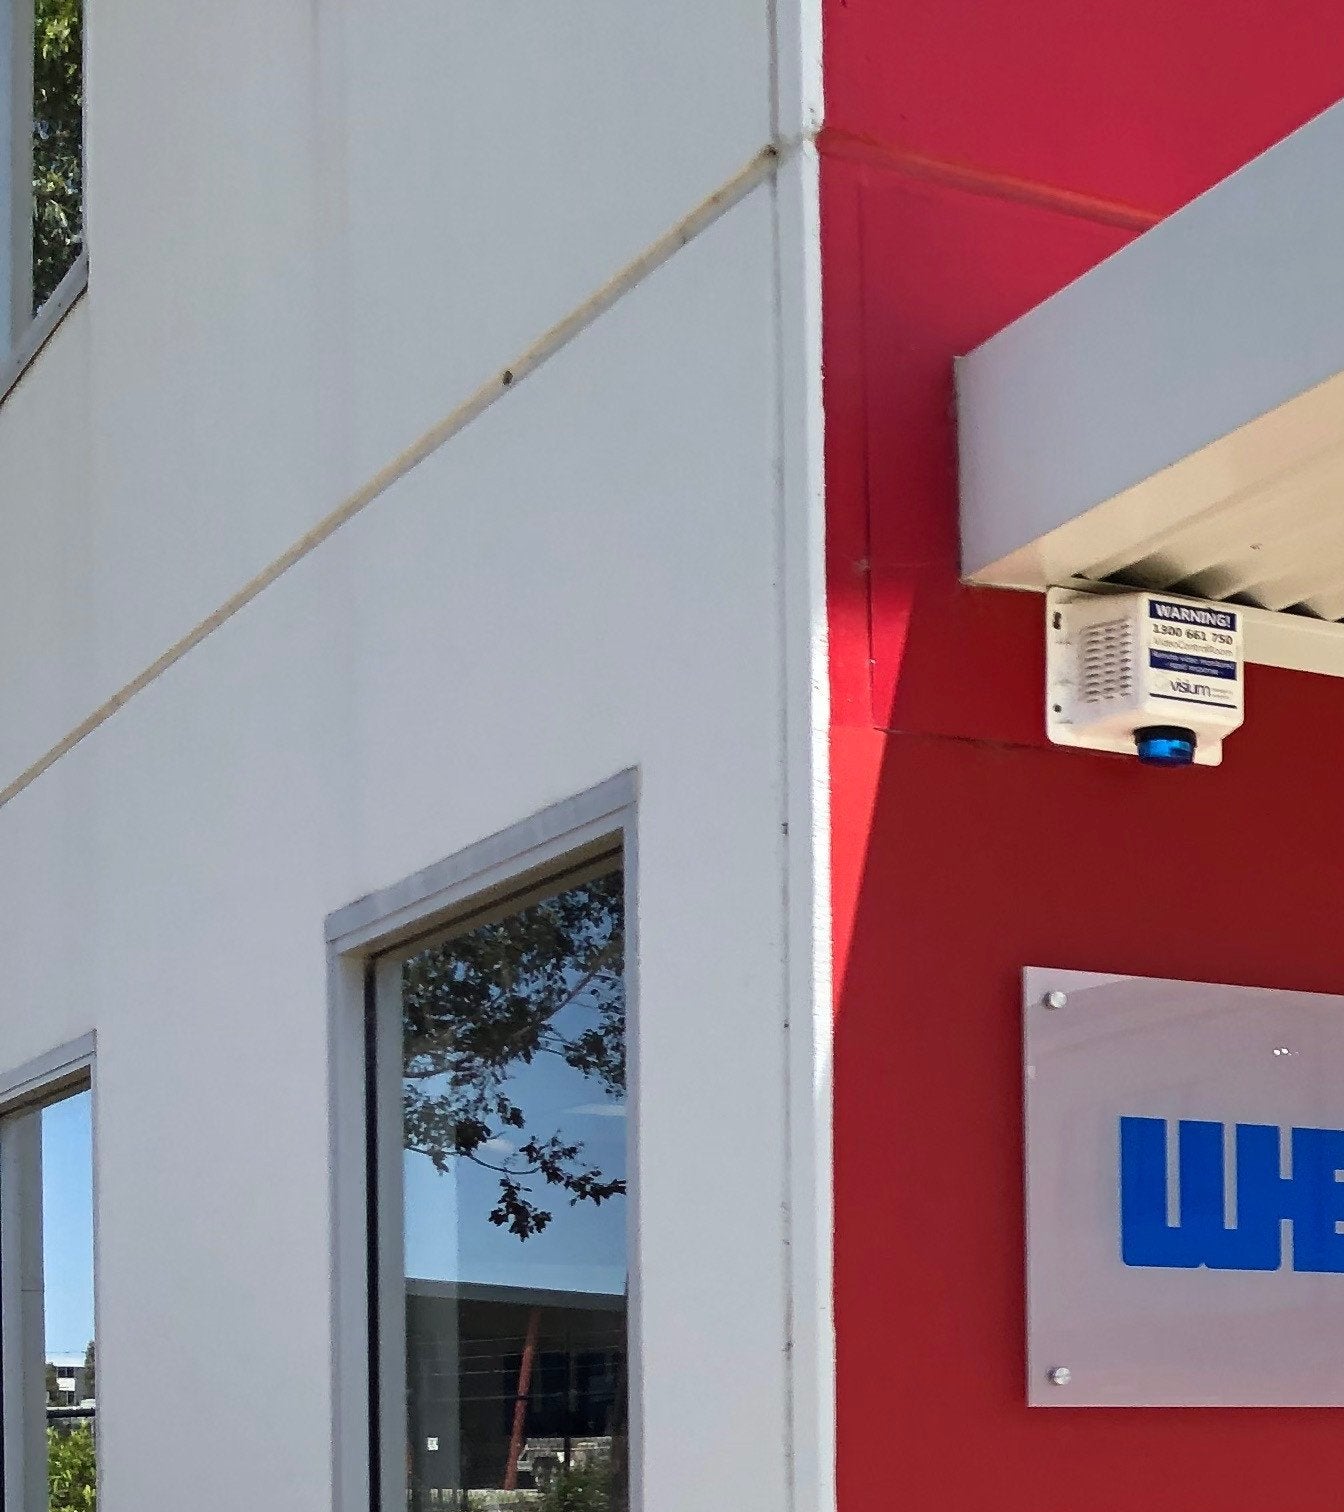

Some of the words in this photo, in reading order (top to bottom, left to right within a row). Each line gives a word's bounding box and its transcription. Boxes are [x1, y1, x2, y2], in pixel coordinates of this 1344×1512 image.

[1155, 603, 1231, 628] WARNING!
[1152, 623, 1182, 638] 1300
[1185, 628, 1207, 642] 661
[1211, 632, 1234, 646] 750
